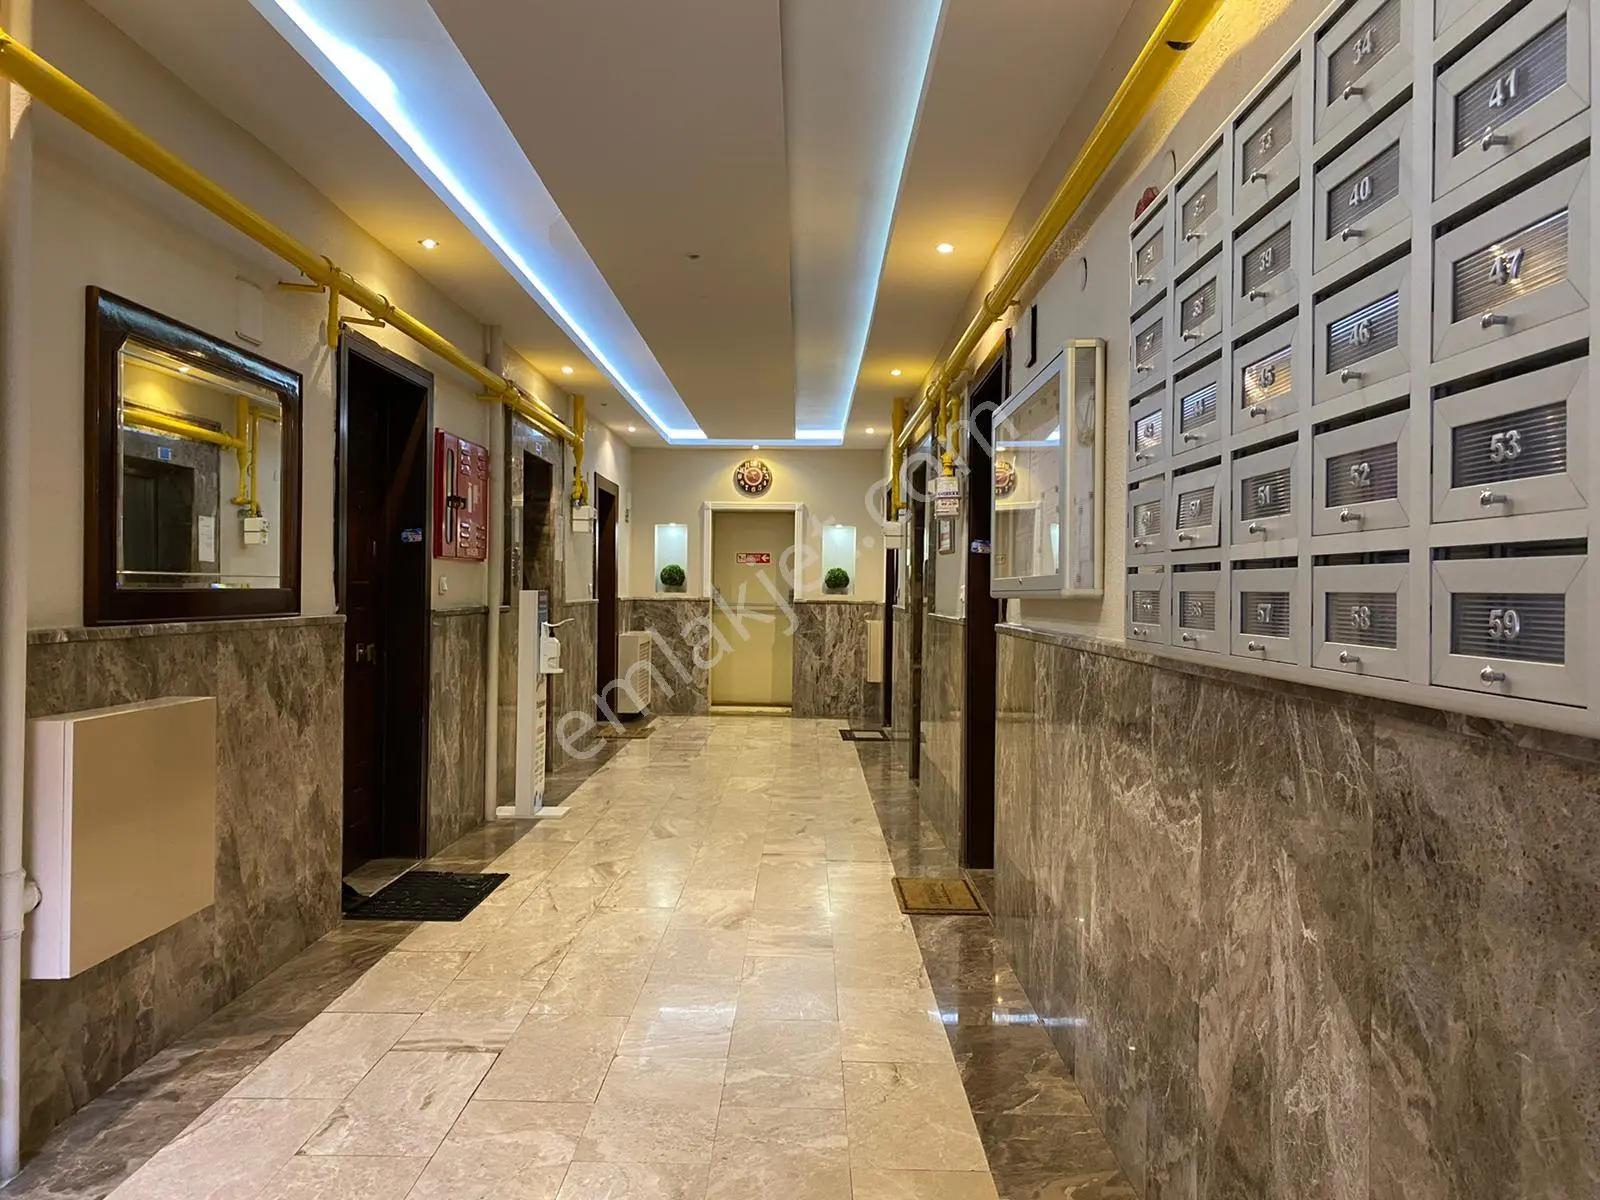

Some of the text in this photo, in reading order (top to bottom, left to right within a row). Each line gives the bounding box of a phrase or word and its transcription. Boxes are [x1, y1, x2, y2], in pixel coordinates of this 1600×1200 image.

[1352, 29, 1373, 65] 34
[1488, 68, 1518, 108] 41
[1348, 176, 1373, 207] 40
[1258, 247, 1273, 272] 39
[1488, 248, 1522, 285] 47
[1348, 319, 1375, 347] 46
[1489, 430, 1520, 462] 53
[1350, 462, 1371, 488] 52
[1257, 484, 1271, 506] 51
[1256, 602, 1271, 624] 57
[1350, 605, 1371, 632] 58
[1488, 610, 1519, 640] 59
